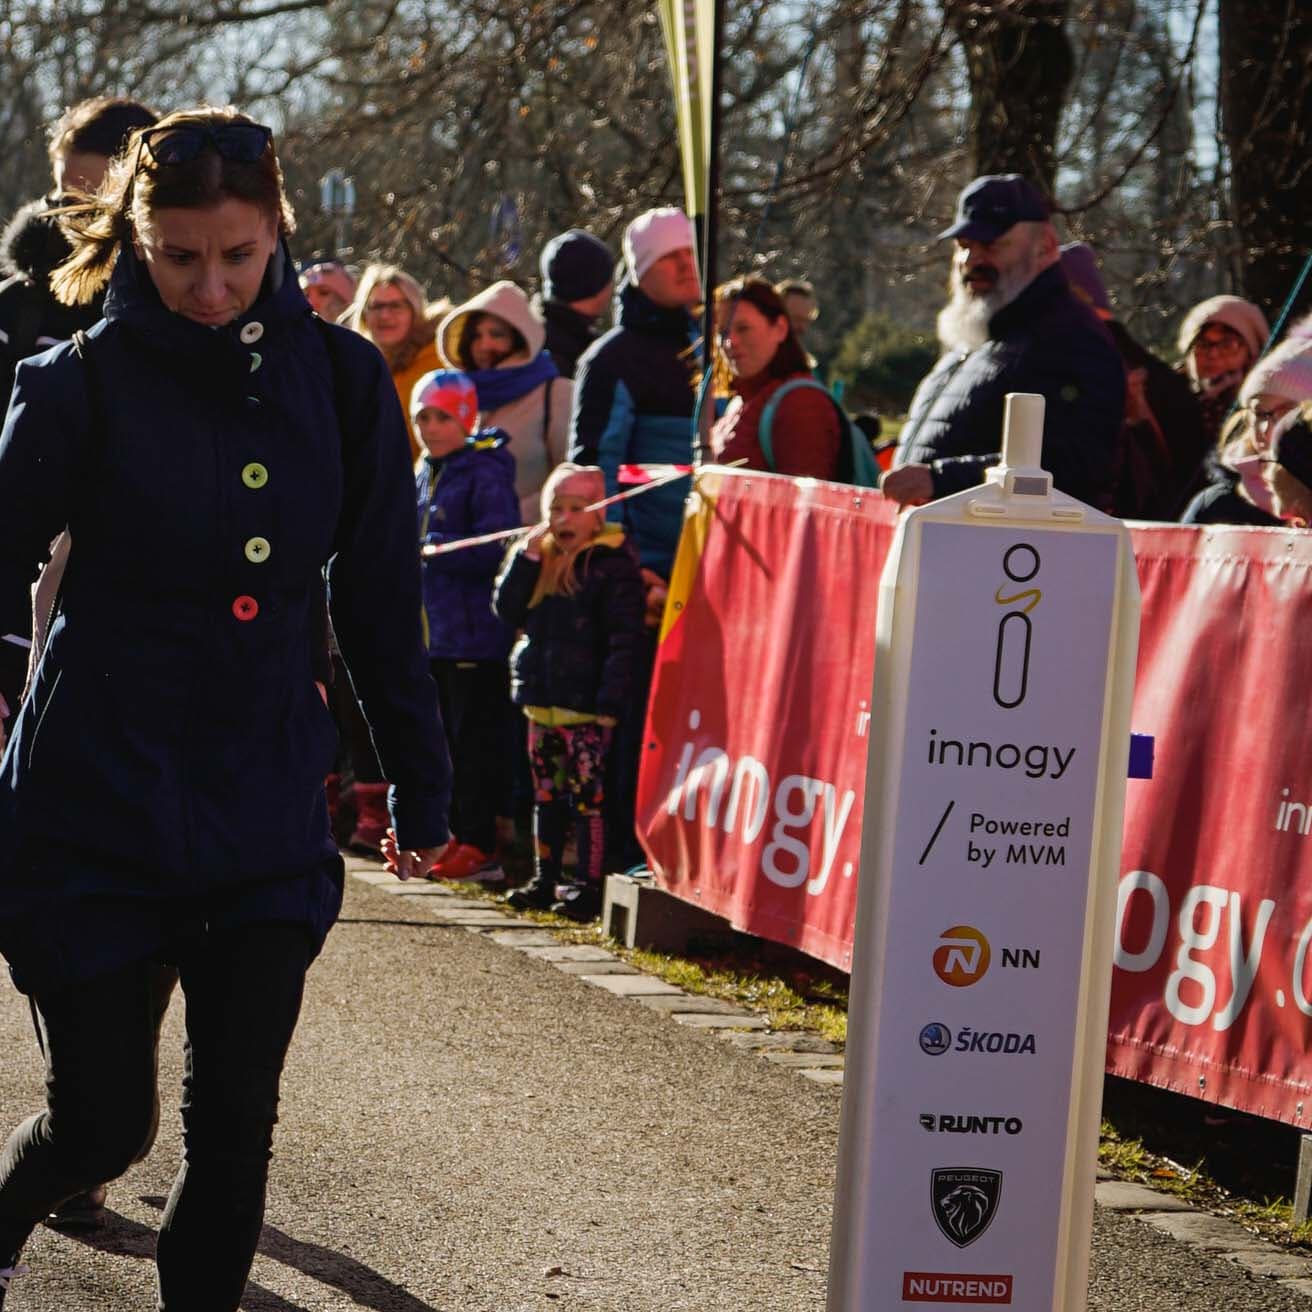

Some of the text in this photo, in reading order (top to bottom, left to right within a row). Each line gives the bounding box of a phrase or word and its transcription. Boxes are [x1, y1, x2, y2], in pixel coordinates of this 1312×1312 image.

[928, 729, 1076, 779] innogy
[970, 813, 1070, 838] Powered
[968, 842, 1066, 868] by MVM
[1001, 948, 1041, 969] NN
[955, 1027, 1037, 1054] ŠKODA
[939, 1115, 1023, 1135] RUNTO
[937, 1174, 995, 1183] PEUGEOT
[910, 1279, 1007, 1299] NUTREND
